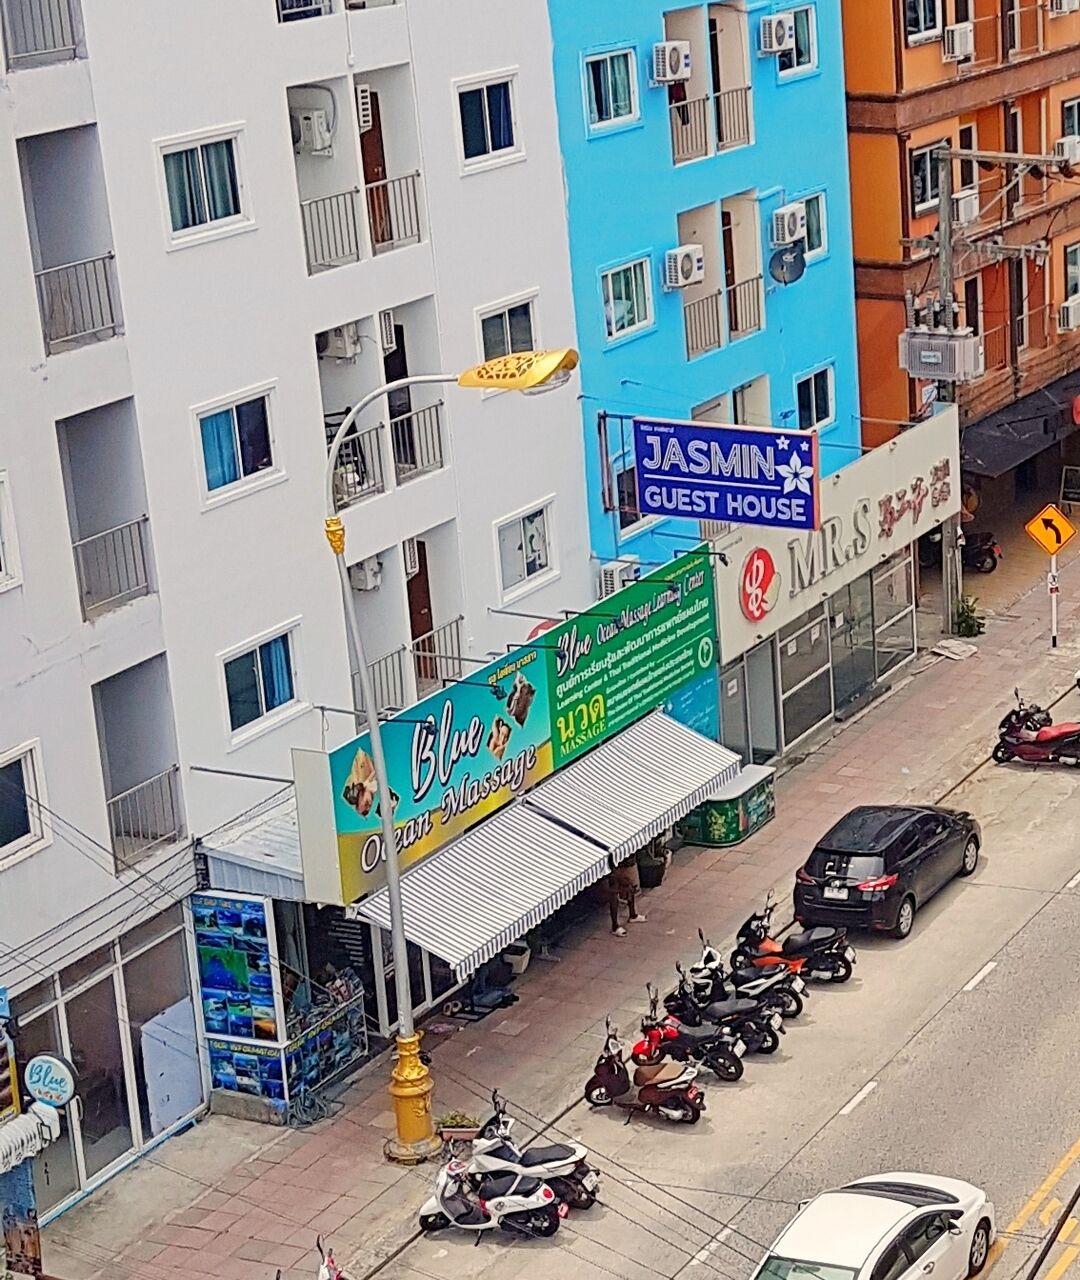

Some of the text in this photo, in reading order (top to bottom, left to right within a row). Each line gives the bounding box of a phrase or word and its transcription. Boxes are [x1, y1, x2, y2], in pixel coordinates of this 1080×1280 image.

[642, 434, 776, 481] JASMIN
[644, 485, 807, 522] GUEST HOUSE
[556, 624, 593, 678] Blue
[556, 693, 606, 742] นวด
[560, 719, 607, 758] MASSAGE
[411, 699, 485, 801] Blue
[441, 745, 537, 825] Massage
[29, 1063, 68, 1088] Blue
